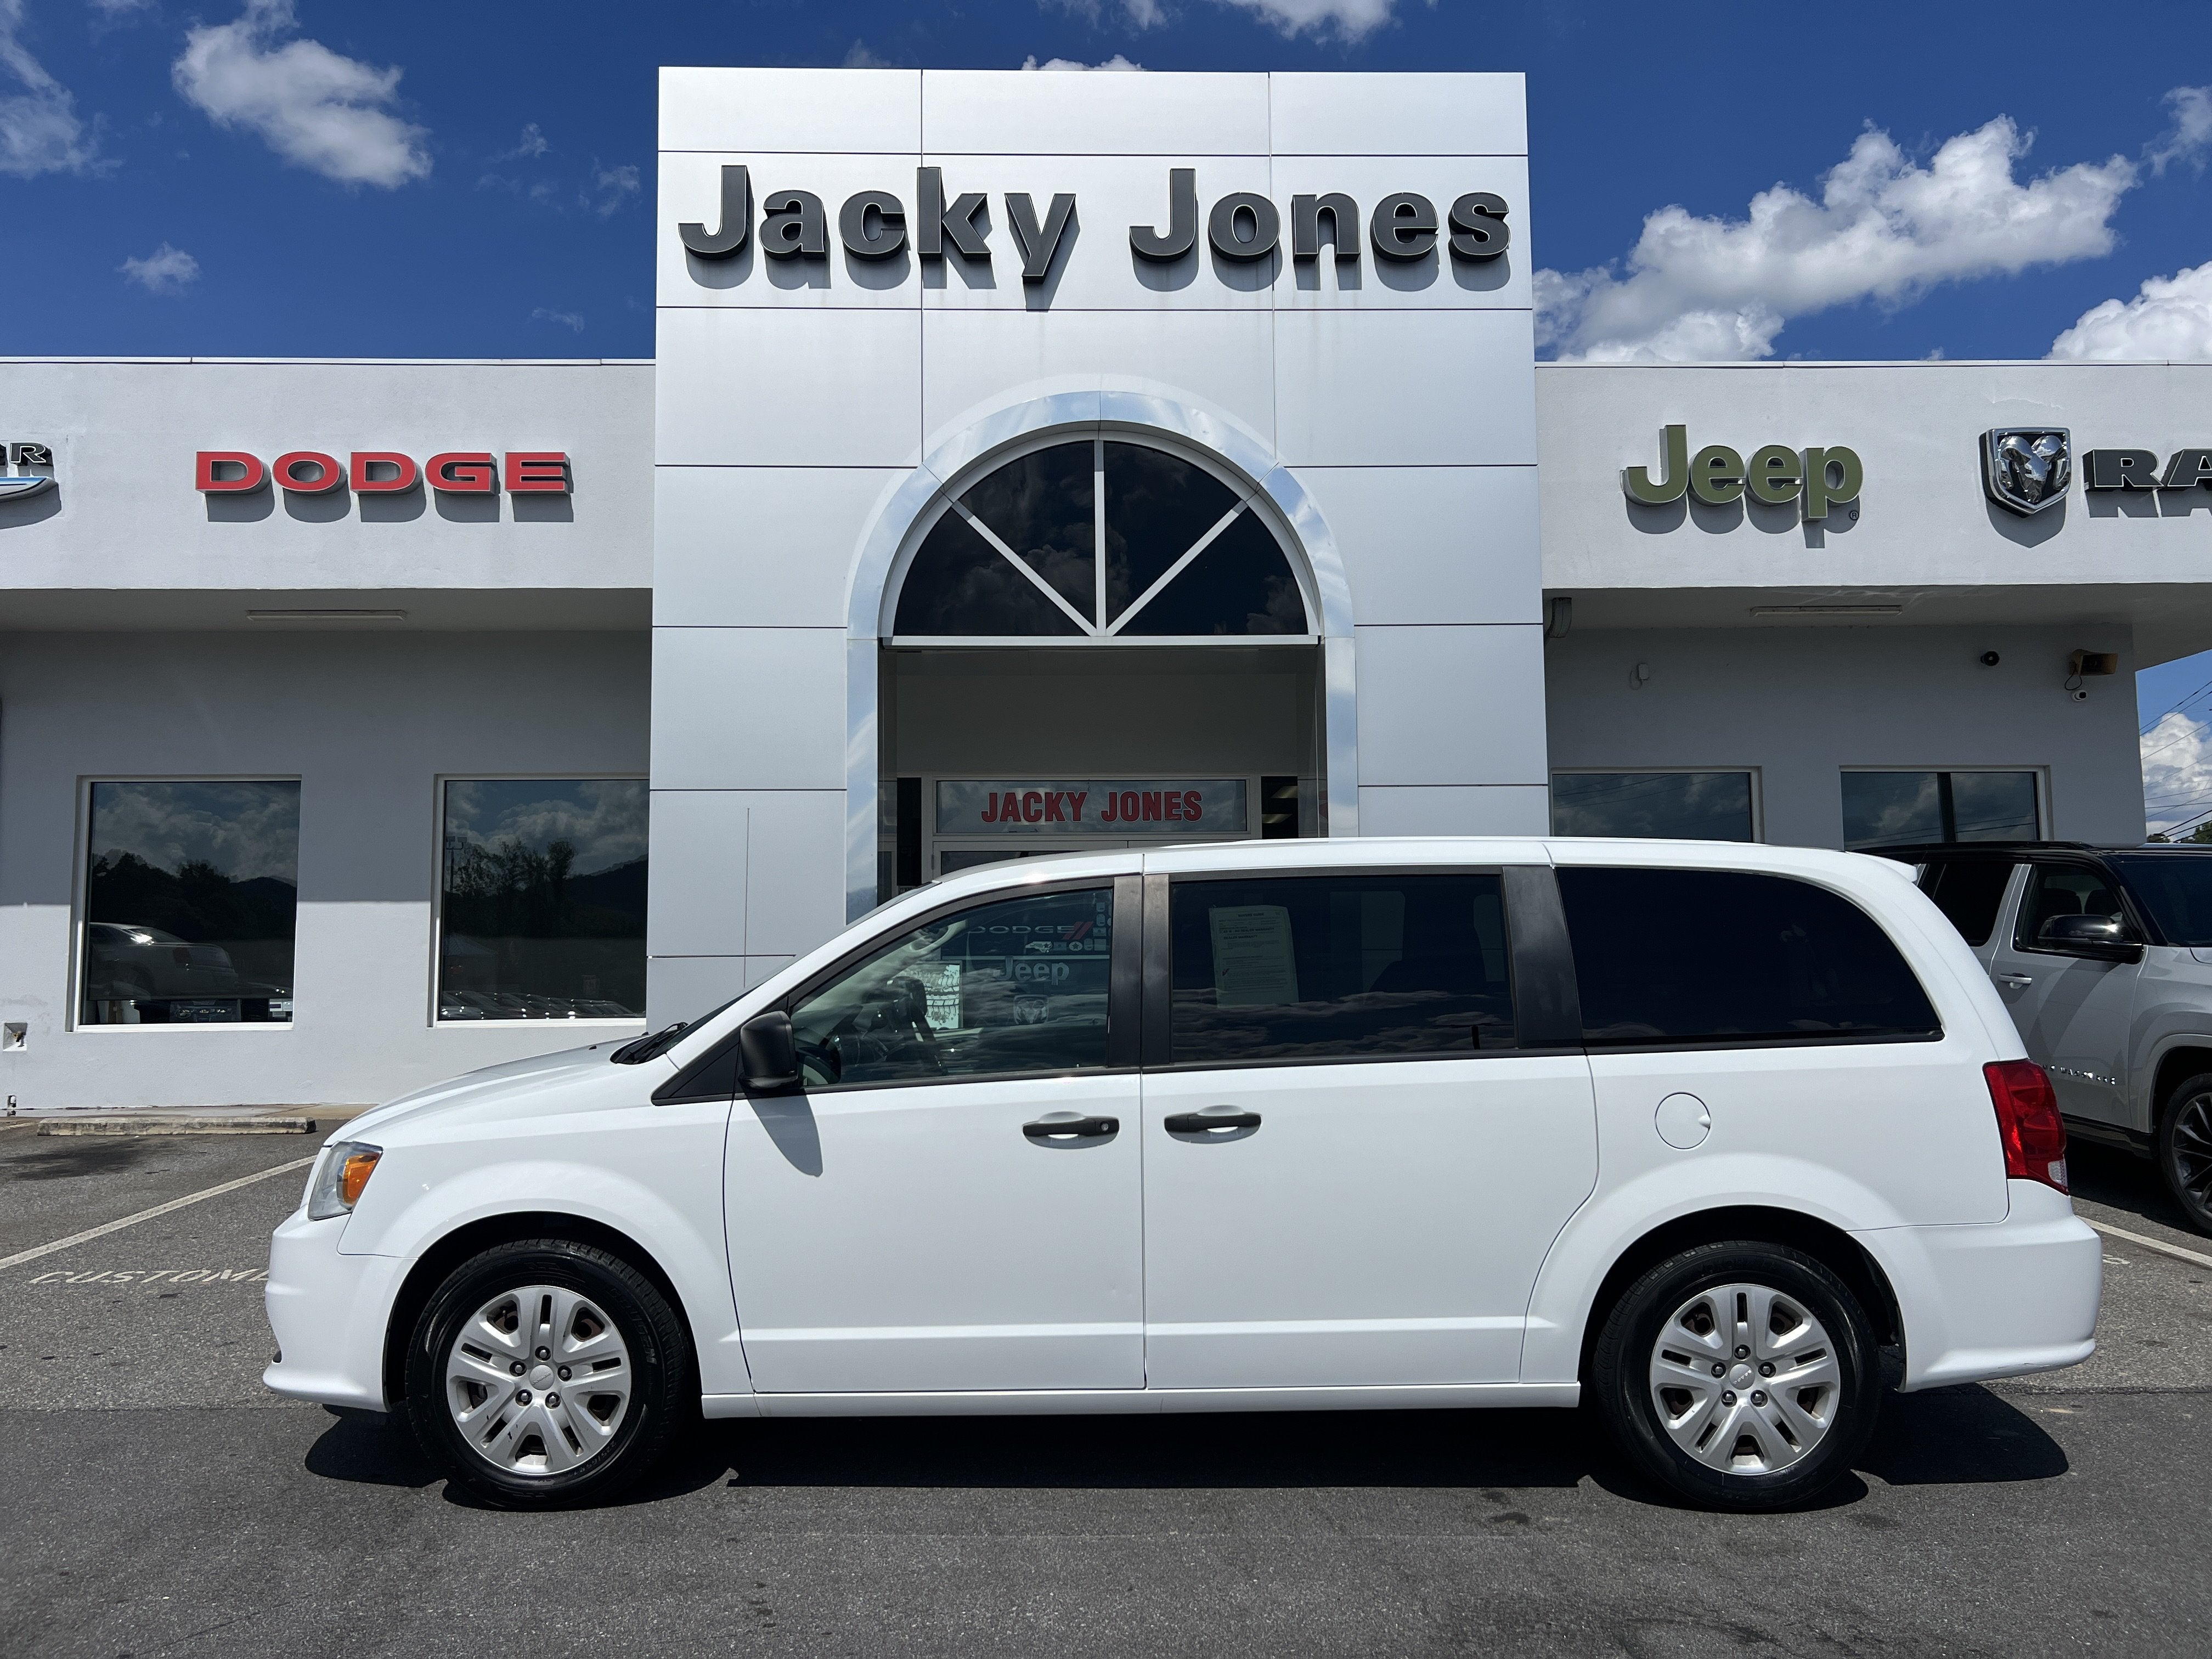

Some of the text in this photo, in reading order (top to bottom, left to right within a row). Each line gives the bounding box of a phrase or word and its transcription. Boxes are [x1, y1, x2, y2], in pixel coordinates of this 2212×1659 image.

[678, 165, 1511, 282] Jacky Jones
[195, 451, 567, 493] DODGE
[1622, 424, 1864, 520] Jeep
[981, 790, 1203, 822] JACKY JONES
[994, 956, 1070, 986] Jeep
